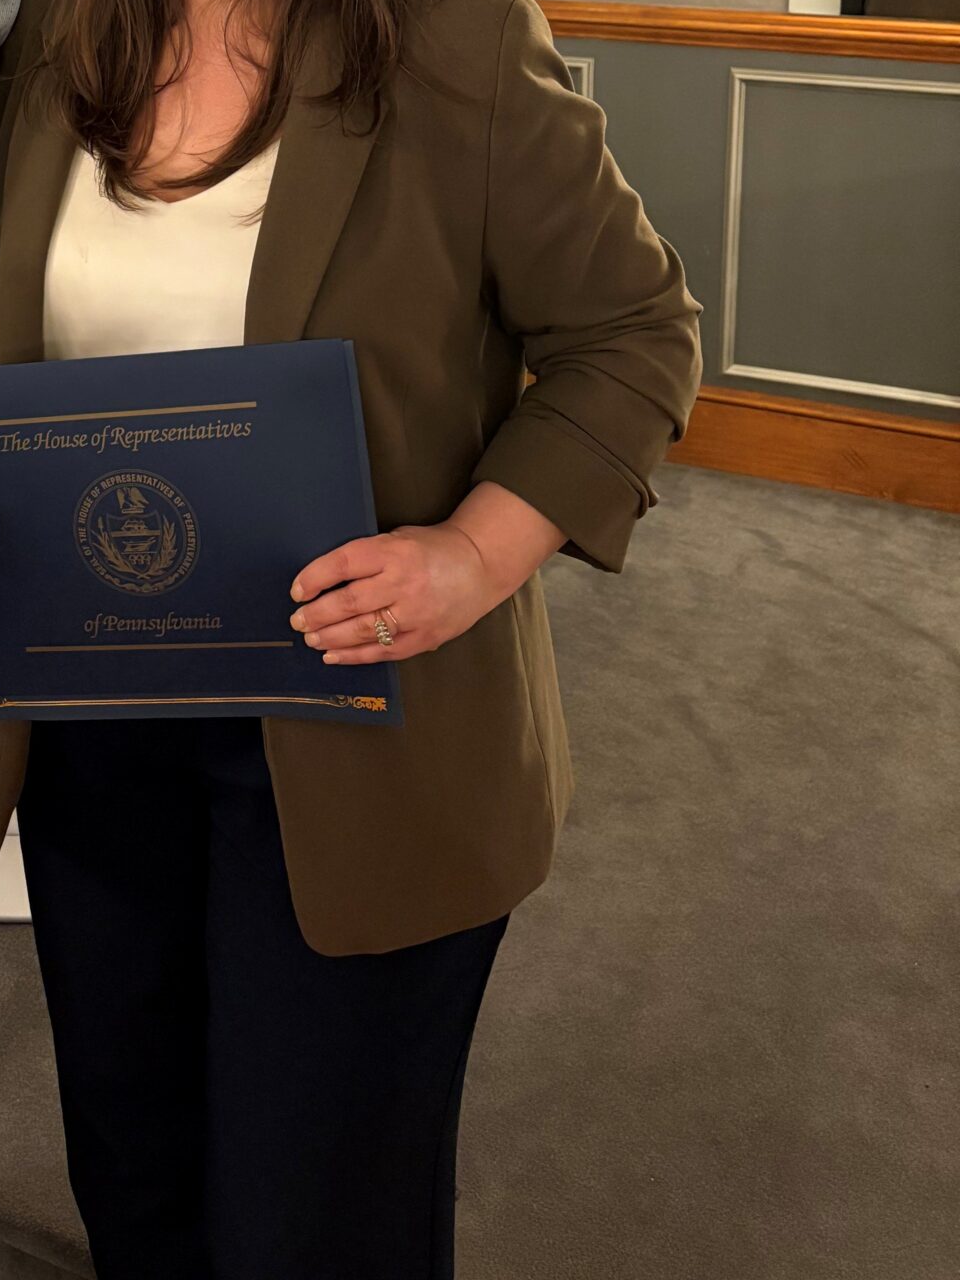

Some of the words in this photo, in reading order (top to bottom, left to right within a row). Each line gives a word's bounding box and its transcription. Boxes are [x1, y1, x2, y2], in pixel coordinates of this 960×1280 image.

[33, 429, 88, 451] House
[90, 425, 110, 454] of
[110, 420, 252, 452] Representatives
[90, 487, 102, 499] OF
[101, 473, 175, 498] REPRESENTATIVES
[78, 498, 93, 524] HOUSE
[173, 496, 185, 508] OF
[78, 527, 87, 543] THE
[84, 613, 103, 638] of
[103, 611, 223, 637] Pennsylvania
